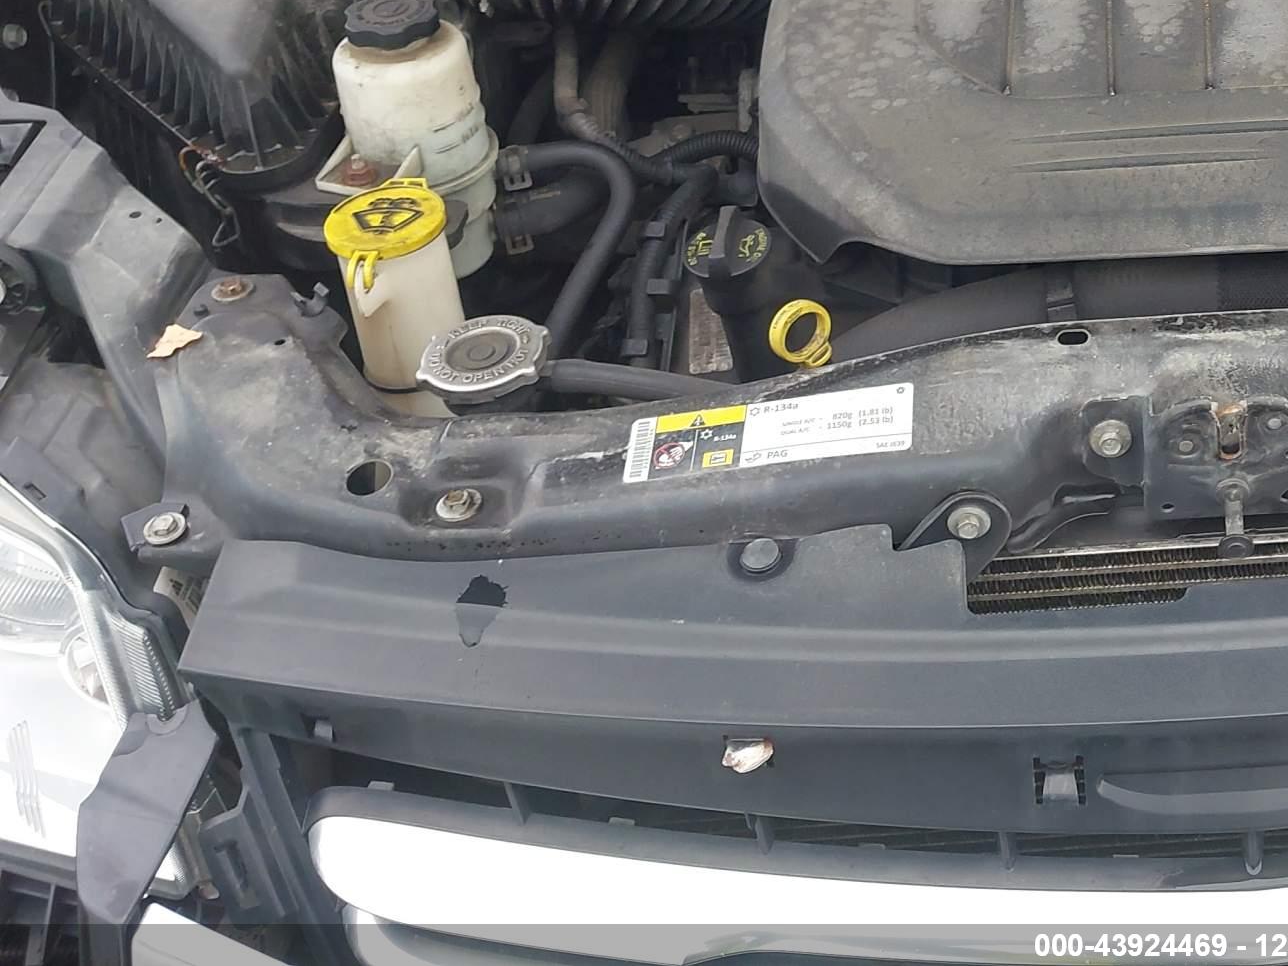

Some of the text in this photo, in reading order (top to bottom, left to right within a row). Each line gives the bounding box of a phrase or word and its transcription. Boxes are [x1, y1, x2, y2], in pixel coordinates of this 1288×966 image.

[448, 319, 488, 339] KEEP
[432, 364, 458, 382] NOT
[462, 368, 504, 382] OPEN
[763, 402, 799, 414] R-134a
[832, 410, 853, 421] 820g
[858, 408, 880, 418] (1.81
[882, 406, 894, 416] lb)
[826, 420, 852, 430] 1150g
[858, 416, 880, 427] (2.53
[882, 416, 894, 425] lb)
[766, 449, 788, 459] PAG
